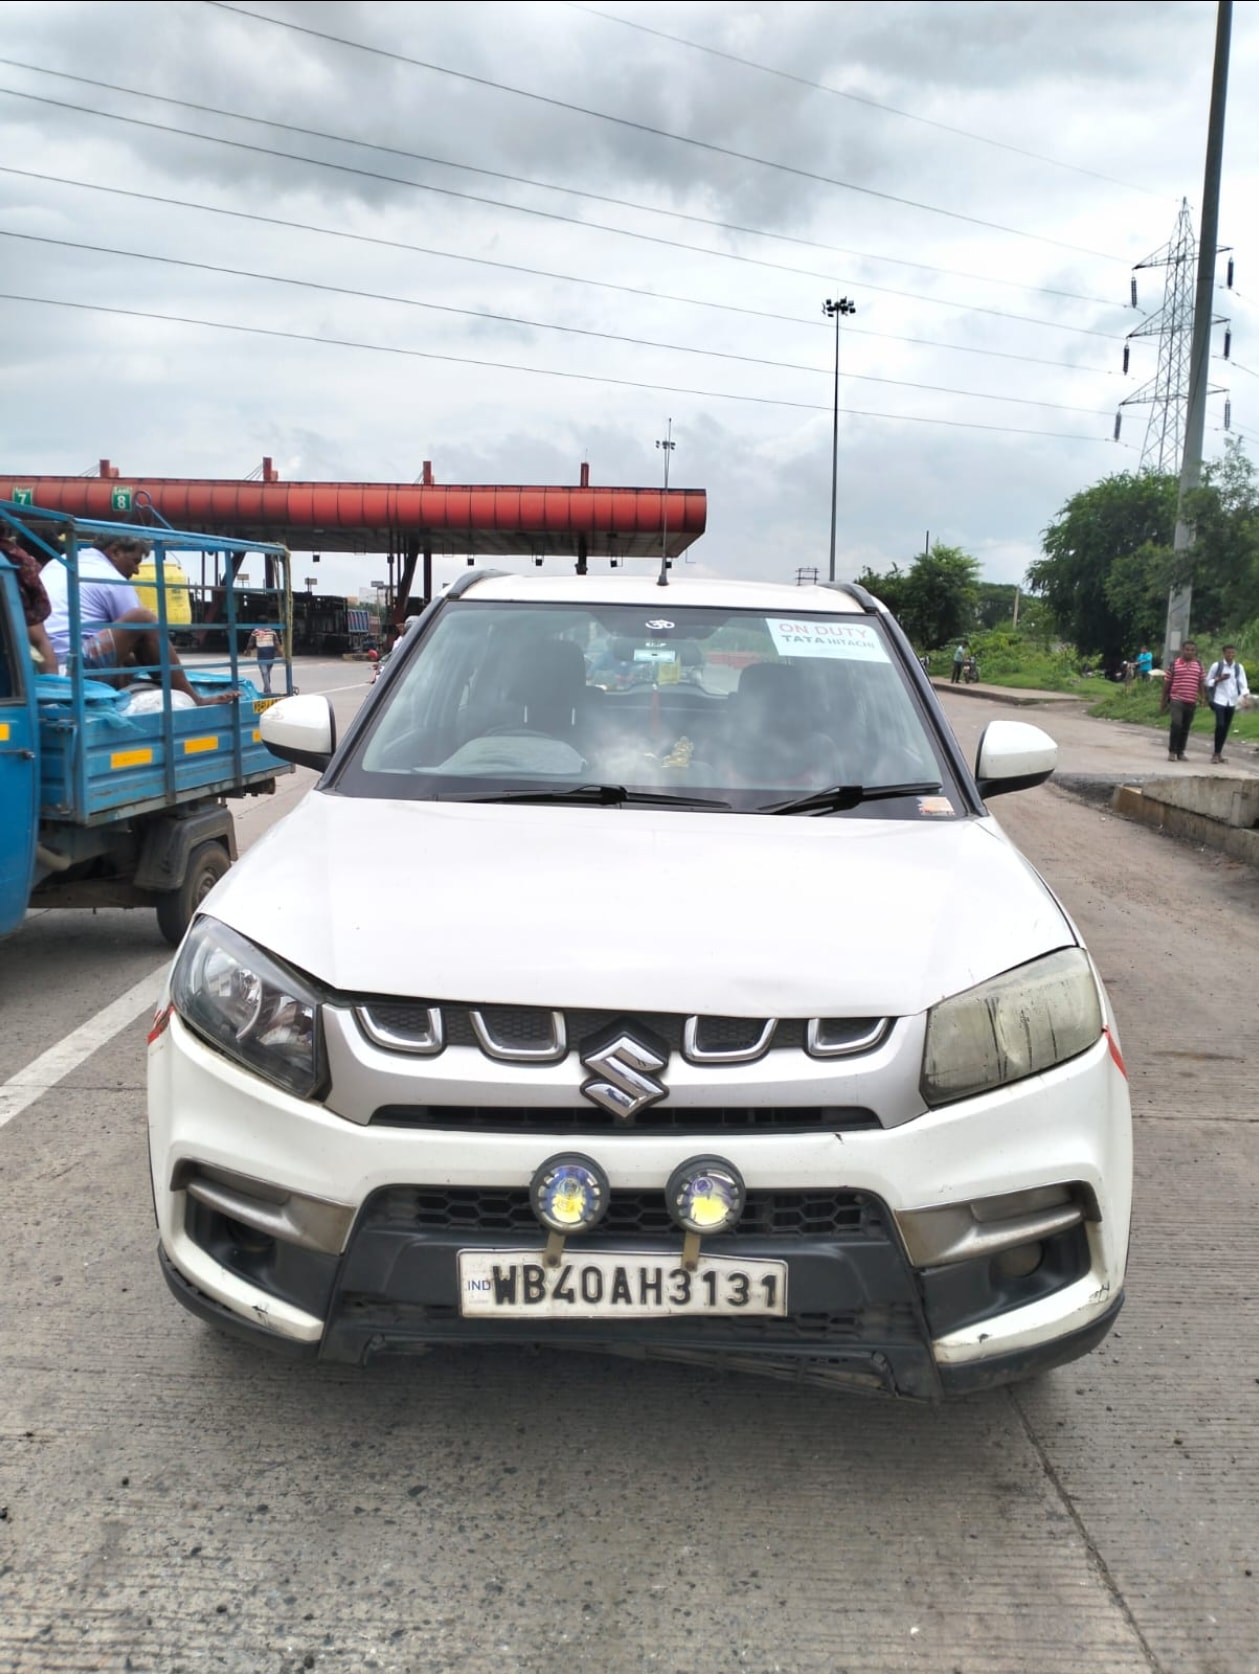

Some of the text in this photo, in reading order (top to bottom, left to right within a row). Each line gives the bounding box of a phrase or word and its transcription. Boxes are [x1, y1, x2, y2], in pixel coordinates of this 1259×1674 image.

[18, 494, 27, 505] 7
[117, 495, 126, 509] 8
[779, 623, 867, 639] ON DUTY
[781, 634, 875, 649] TATA HITACHI
[467, 1264, 779, 1308] IND WB40AH3131
